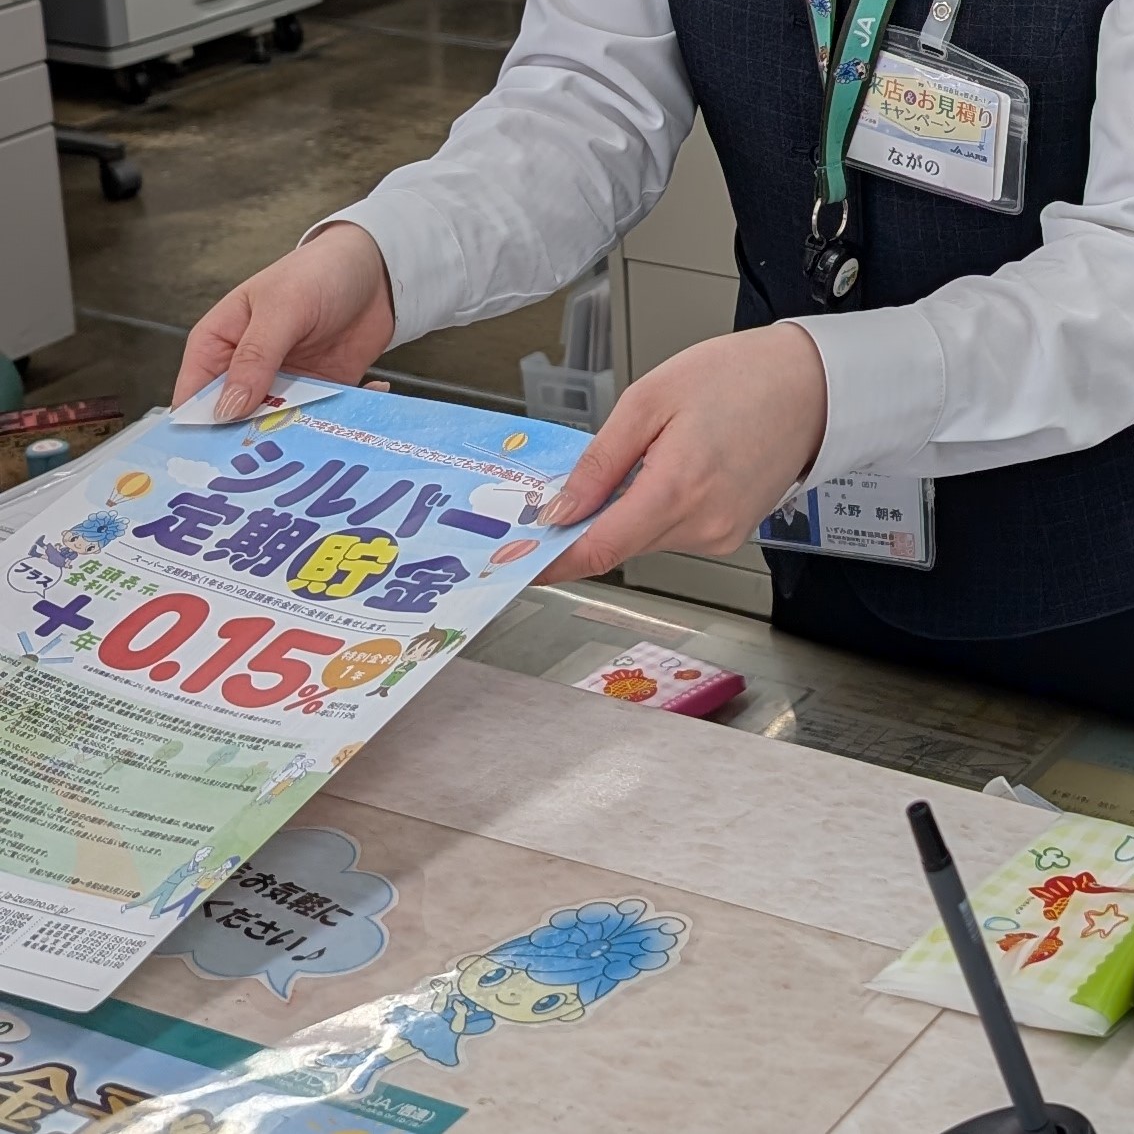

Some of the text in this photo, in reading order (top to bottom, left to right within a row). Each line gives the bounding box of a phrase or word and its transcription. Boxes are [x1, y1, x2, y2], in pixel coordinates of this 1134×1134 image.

[853, 17, 876, 48] JA
[880, 99, 957, 134] キャンペーン
[887, 146, 941, 176] ながの
[207, 440, 512, 539] シルバー
[834, 502, 862, 518] 永野
[132, 491, 471, 614] 定期貯金
[14, 562, 54, 588] プラス
[64, 571, 122, 601] 金利に
[79, 559, 160, 596] 店頭表示
